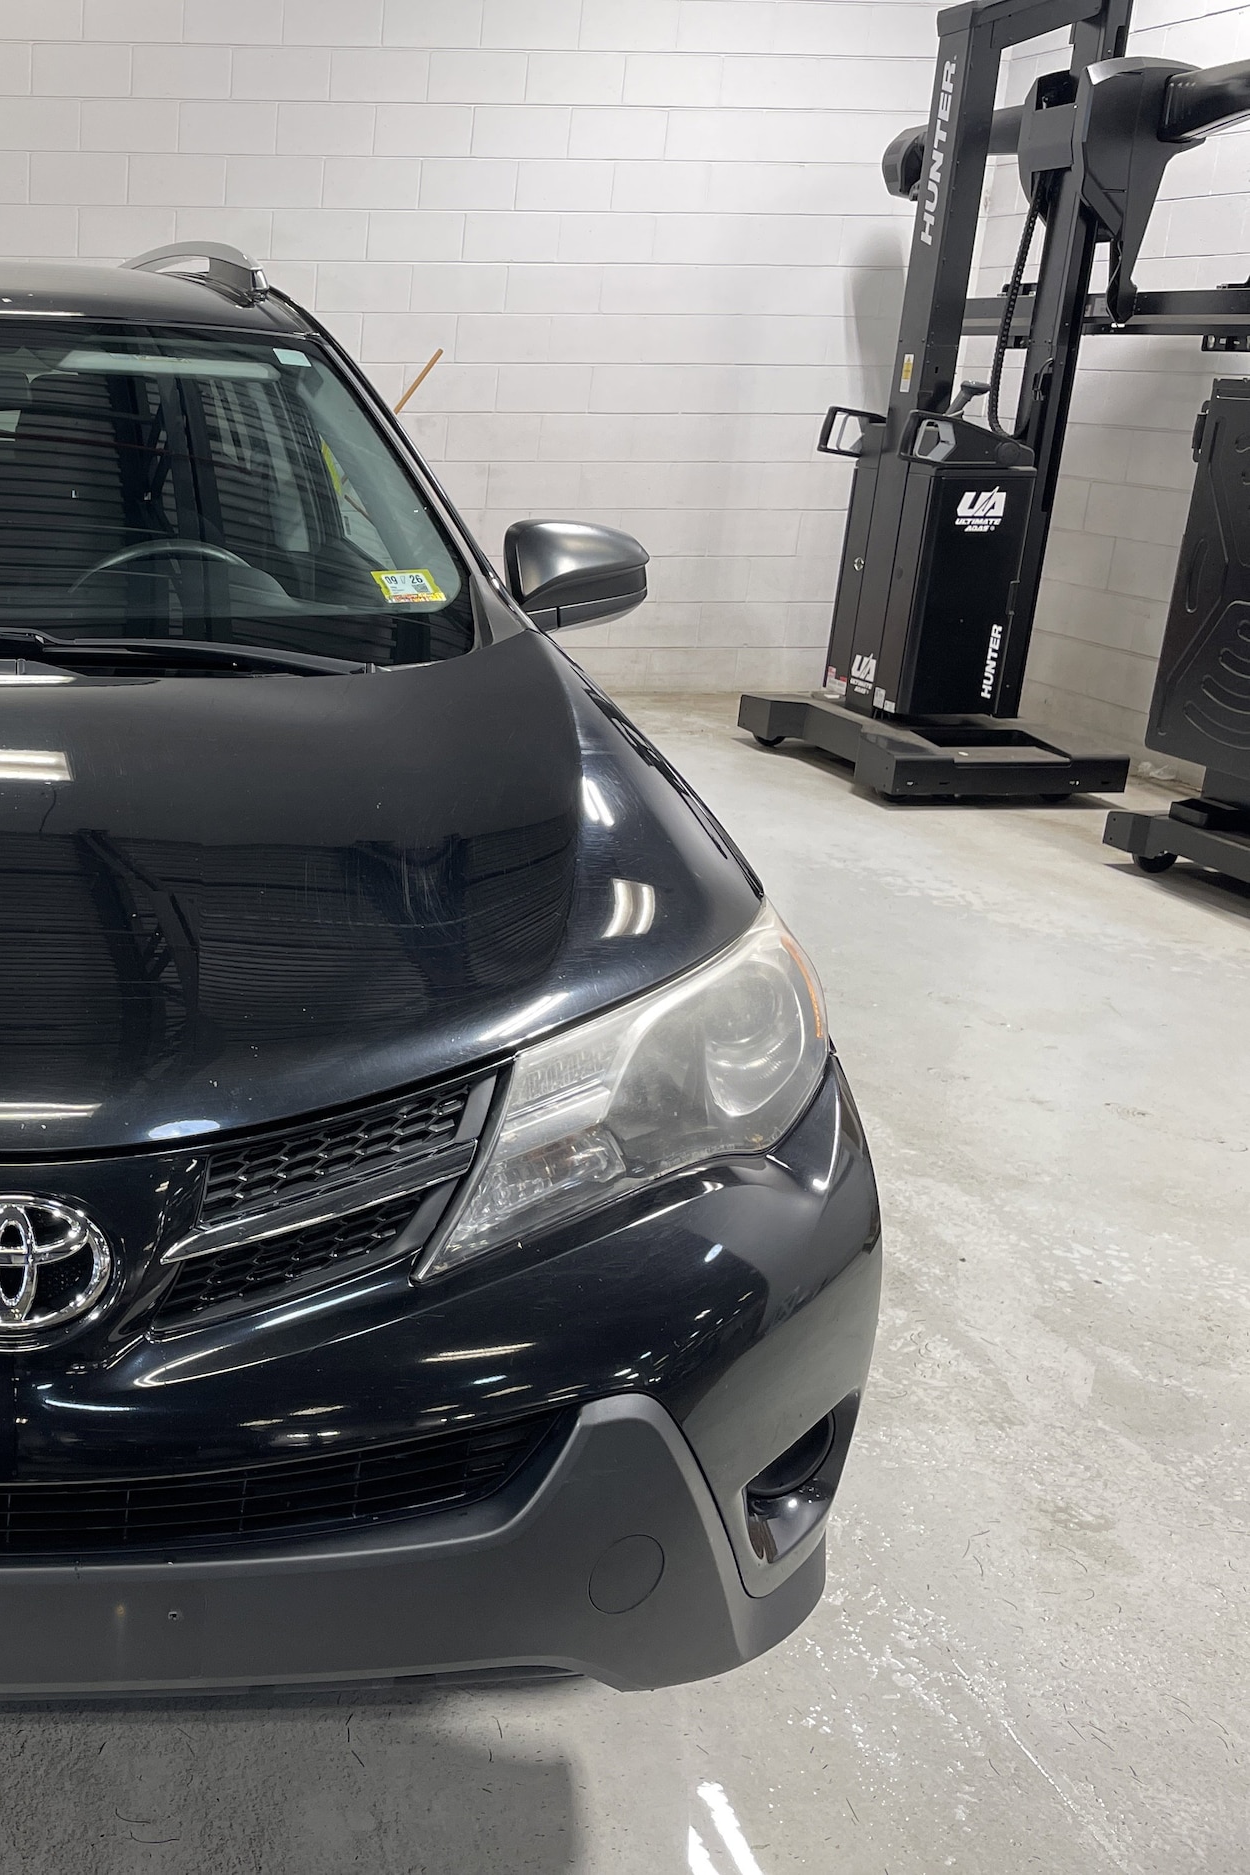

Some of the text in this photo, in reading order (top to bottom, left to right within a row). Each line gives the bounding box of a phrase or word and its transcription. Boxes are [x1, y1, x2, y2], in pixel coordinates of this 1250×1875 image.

[920, 60, 956, 246] HUNTER
[954, 517, 1002, 526] ULTIMATE
[409, 574, 423, 584] 26
[980, 623, 1003, 700] HUNTER
